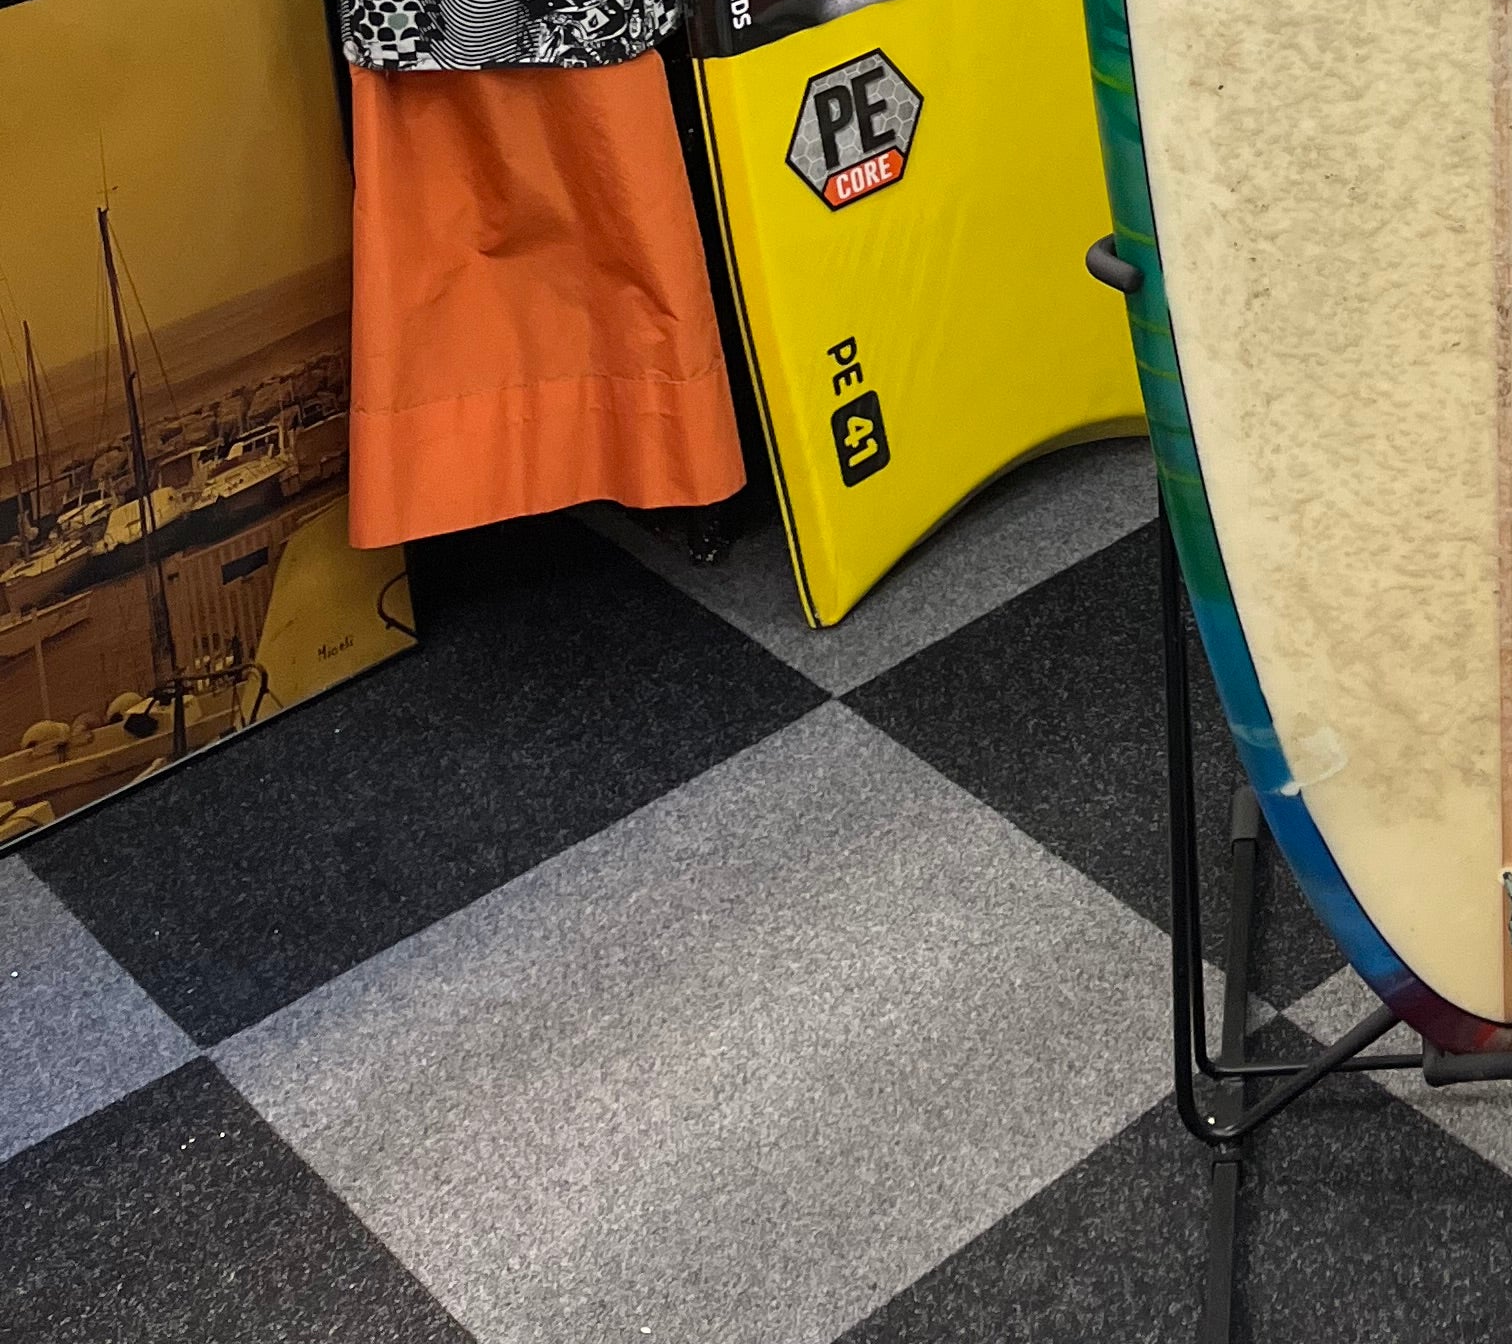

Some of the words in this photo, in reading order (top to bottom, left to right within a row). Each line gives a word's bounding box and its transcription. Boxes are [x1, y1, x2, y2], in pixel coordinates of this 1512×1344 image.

[814, 66, 896, 171] PE
[836, 153, 893, 200] CORE
[827, 336, 864, 397] PE
[844, 416, 878, 468] 41
